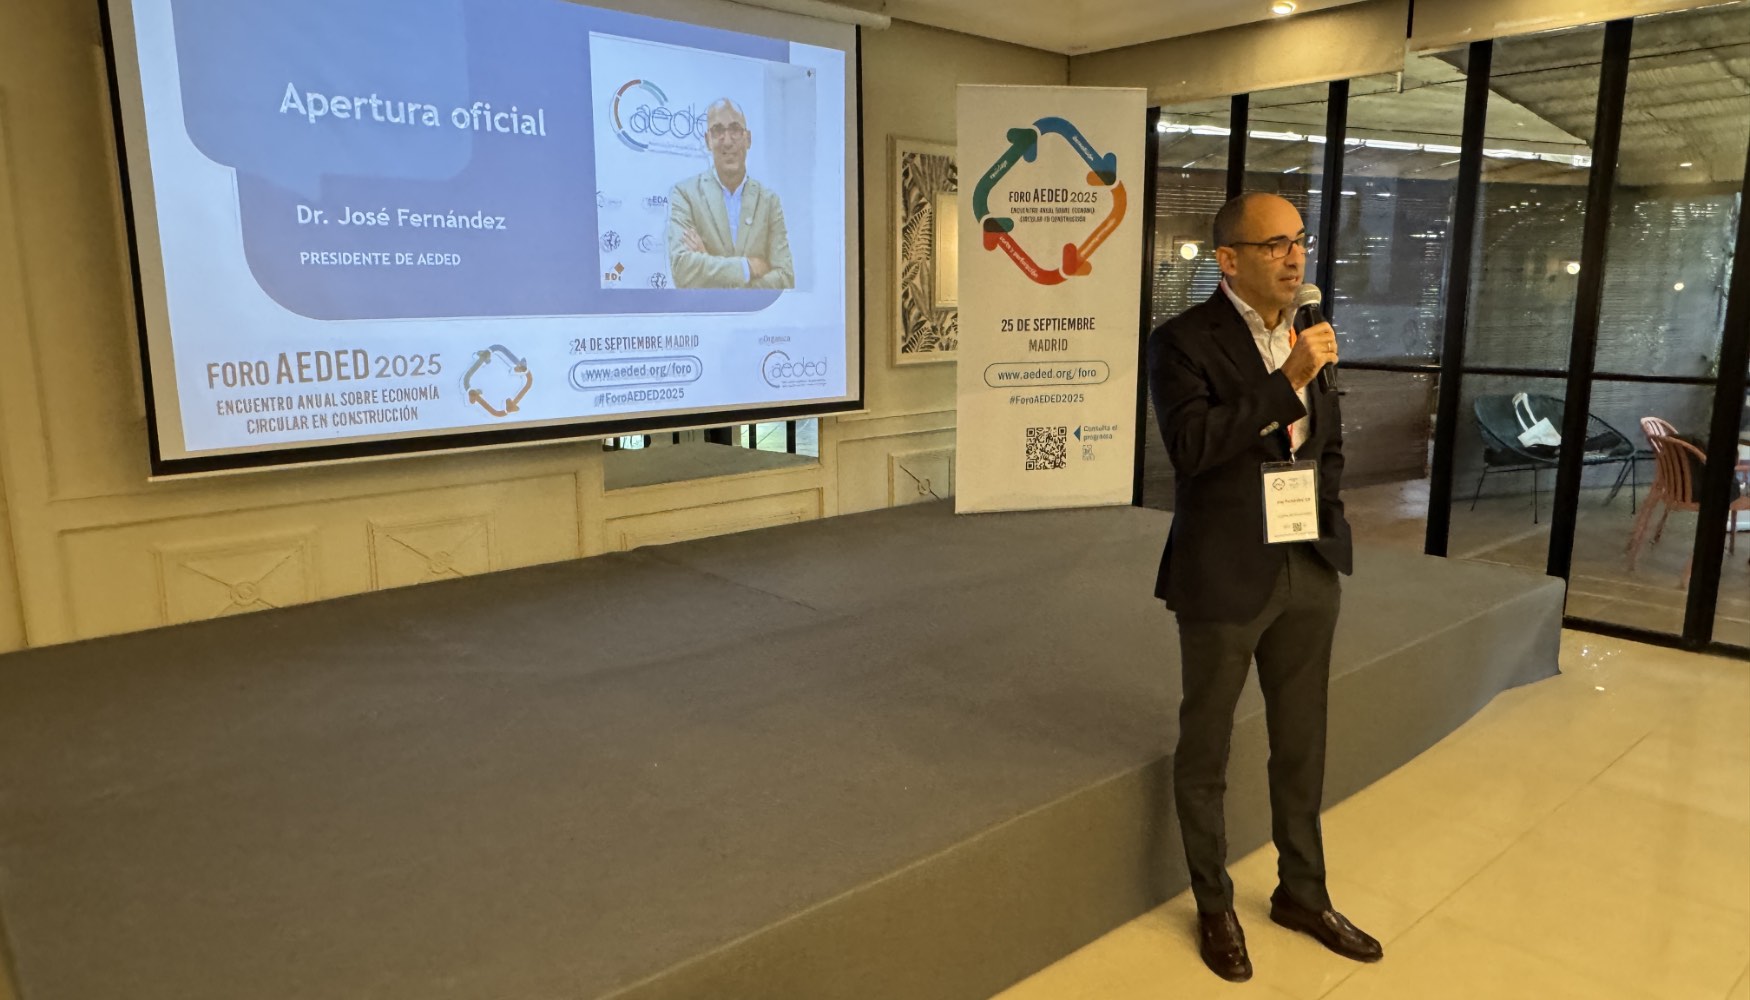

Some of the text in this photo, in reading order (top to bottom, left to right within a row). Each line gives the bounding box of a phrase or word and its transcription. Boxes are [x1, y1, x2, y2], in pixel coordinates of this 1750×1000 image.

[279, 82, 546, 136] Apertura oficial
[1009, 188, 1098, 203] FORO AEDED 2025
[296, 205, 507, 230] Dr. José Fernández
[300, 251, 461, 266] PRESIDENTE DE AEDED
[1001, 317, 1096, 332] 25 DE SEPTIEMBRE
[574, 334, 699, 352] 24 DE SEPTIEMBRE MADRID
[1028, 338, 1068, 352] MADRID
[206, 348, 442, 389] FORO AEDED 2025
[583, 361, 692, 380] www.aeded.org/foro
[772, 356, 827, 378] aeded
[998, 368, 1097, 381] www.aeded.org/foro
[216, 383, 440, 416] ENCUENTRO ANUAL SOBRE ECONOMÍA
[596, 388, 685, 407] #ForoAEDED2025
[1009, 393, 1085, 405] #ForoAEDED2025
[246, 404, 419, 435] CIRCULAR EN CONSTRUCCIÓN
